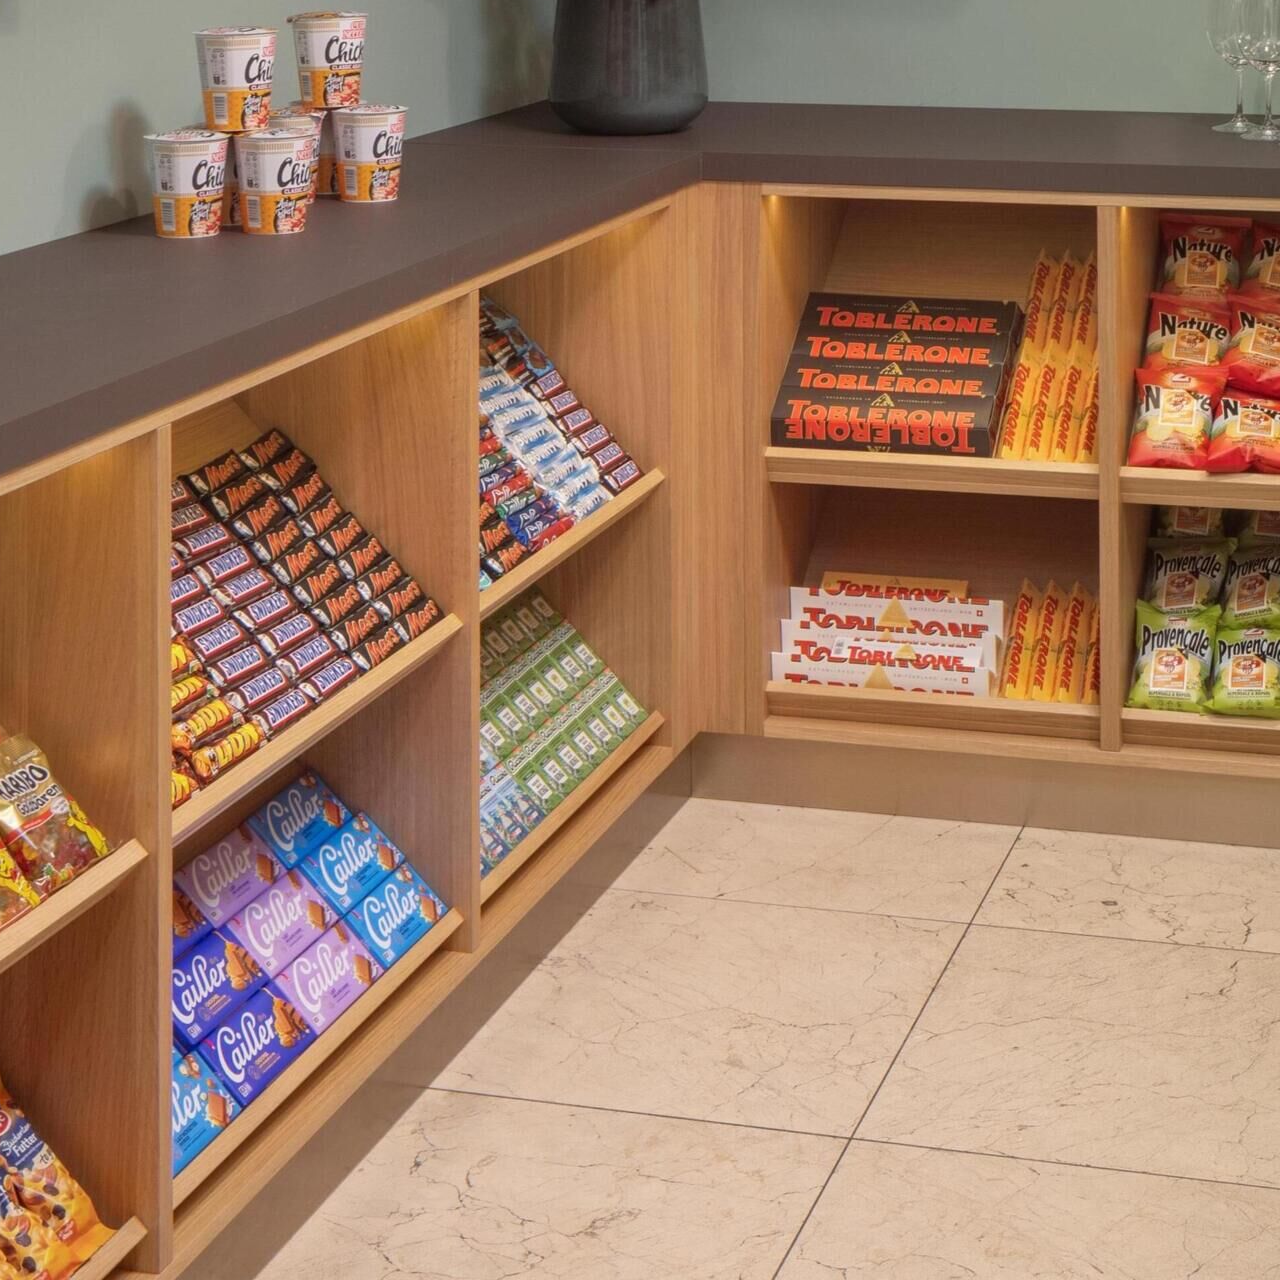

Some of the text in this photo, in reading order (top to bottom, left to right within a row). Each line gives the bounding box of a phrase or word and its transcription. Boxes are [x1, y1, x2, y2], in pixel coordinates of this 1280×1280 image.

[1172, 237, 1232, 262] Nature
[817, 306, 998, 334] TOBLERONE
[1051, 261, 1075, 345] TOBLERONE
[807, 336, 990, 365] TOBLERONE
[797, 368, 983, 396] TOBLERONE
[787, 399, 975, 428] TOBLERONE
[1003, 362, 1031, 451] TOBLERONE
[1029, 362, 1056, 453] TOBLERONE
[1056, 365, 1082, 454] TOBLERONE
[785, 418, 975, 453] TOBLERONE
[292, 473, 324, 513] Mars
[310, 498, 342, 535] Mars
[188, 526, 226, 549] SNICKERS
[330, 518, 362, 554] Mars
[209, 548, 248, 574] SNICKERS
[285, 541, 319, 582] Mars
[350, 537, 382, 576] Mars
[1155, 551, 1222, 580] Provençale
[226, 571, 266, 595] SNICKERS
[306, 563, 341, 603] Mars
[369, 561, 402, 599] Mars
[388, 580, 421, 618] Mars
[178, 601, 221, 628] SNICKERS
[249, 591, 288, 617] SNICKERS
[326, 585, 361, 625] Mars
[405, 600, 438, 639] Mars
[197, 623, 240, 651] SNICKERS
[274, 615, 312, 642] SNICKERS
[345, 607, 379, 648] Mars
[1008, 593, 1032, 688] TOBLERONE
[1033, 594, 1058, 691] TOBLERONE
[1060, 596, 1084, 692] TOBLERONE
[1142, 625, 1210, 657] Provençale
[220, 646, 261, 677] SNICKERS
[293, 637, 331, 668] SNICKERS
[365, 628, 400, 667] Mars
[243, 670, 285, 700] SNICKERS
[316, 659, 352, 690] SNICKERS
[266, 691, 306, 724] SNICKERS
[217, 723, 260, 764] LION
[267, 789, 319, 851] Cailler
[192, 842, 251, 908] Cailler
[319, 832, 372, 895] Cailler
[245, 889, 301, 957] Cailler
[363, 883, 415, 949] Cailler
[172, 955, 226, 1024] Cailler
[293, 943, 348, 1013] Cailler
[217, 1012, 275, 1083] Cailler
[12, 1133, 38, 1158] Futter
